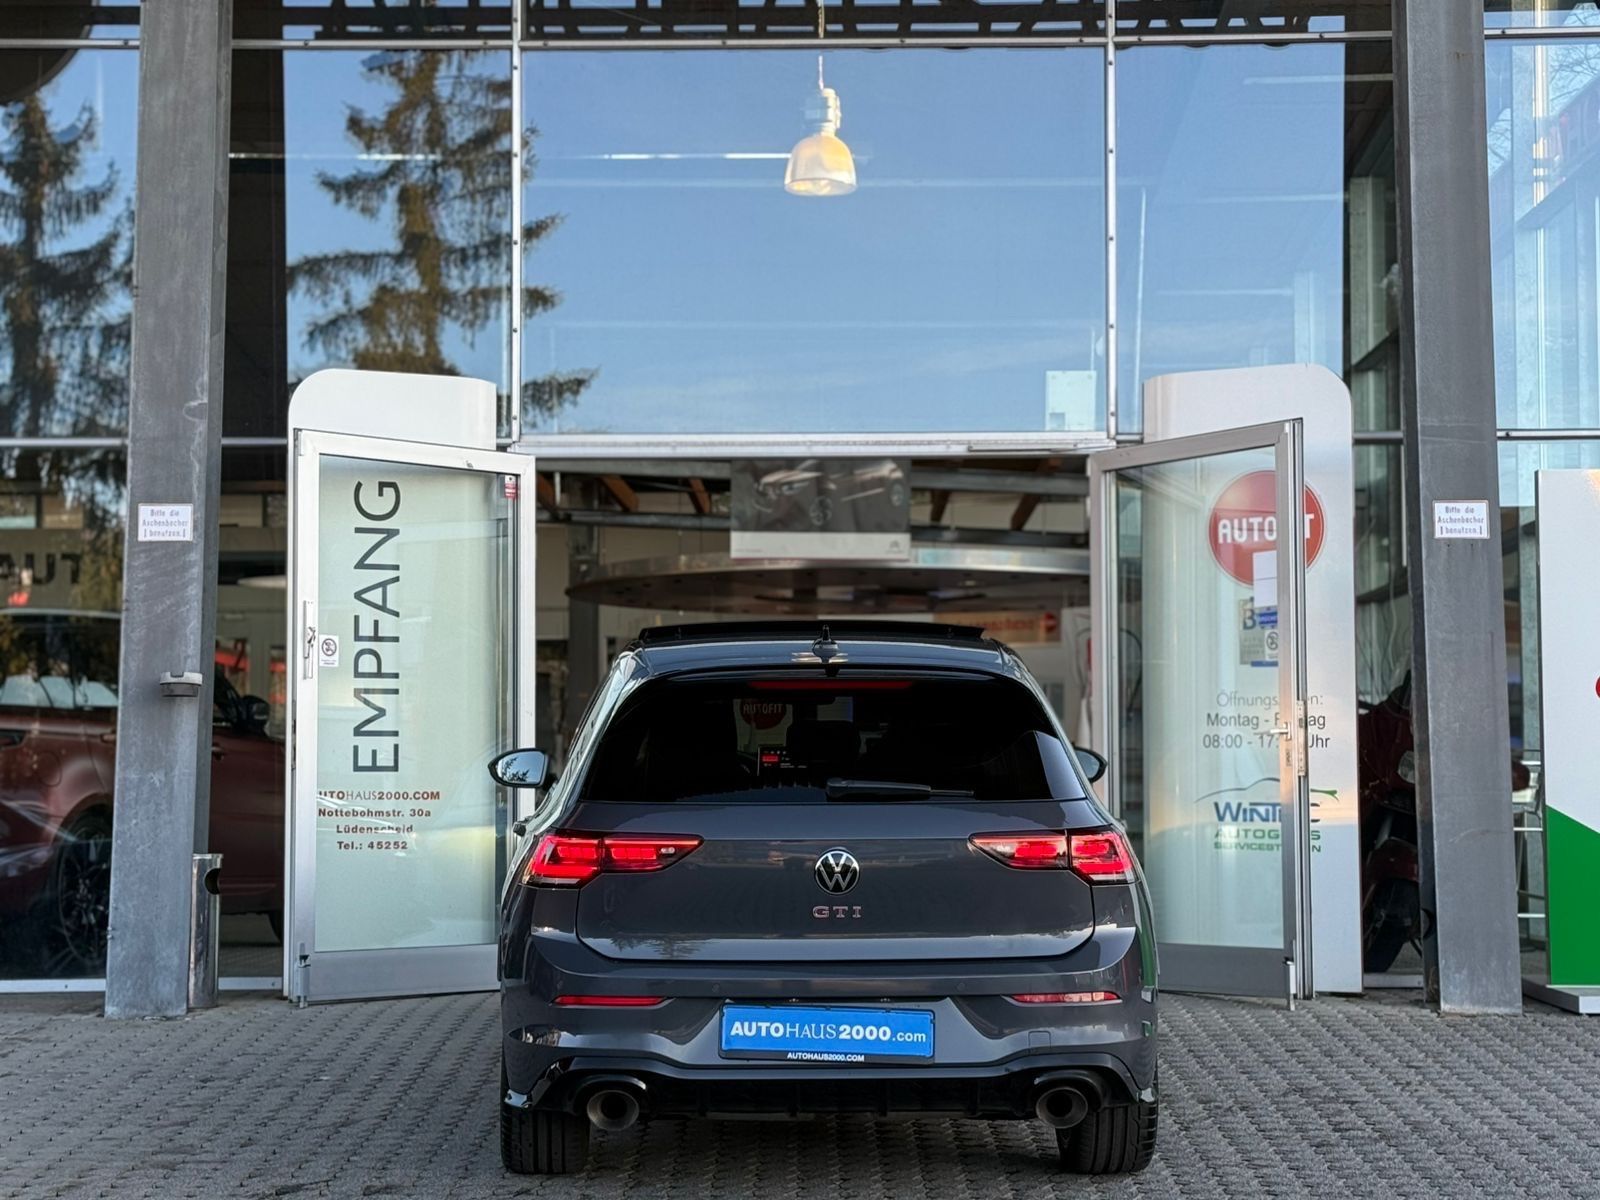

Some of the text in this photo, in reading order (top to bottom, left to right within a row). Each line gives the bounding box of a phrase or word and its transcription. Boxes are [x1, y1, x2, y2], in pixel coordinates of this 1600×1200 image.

[1218, 513, 1315, 544] AUTOT
[353, 481, 400, 772] EMPFANG
[743, 703, 783, 714] AUTOFIT
[1206, 712, 1260, 730] Montag
[1203, 734, 1243, 749] 08:00
[318, 808, 431, 817] Nottebohmstr. 30a
[1214, 828, 1321, 840] AUTOGS
[337, 841, 408, 850] Tel.: 45252
[812, 905, 862, 918] GTI
[730, 1021, 926, 1043] AUTOHAUS2000.com
[787, 1052, 865, 1062] AUTOHAUS2000.COM
